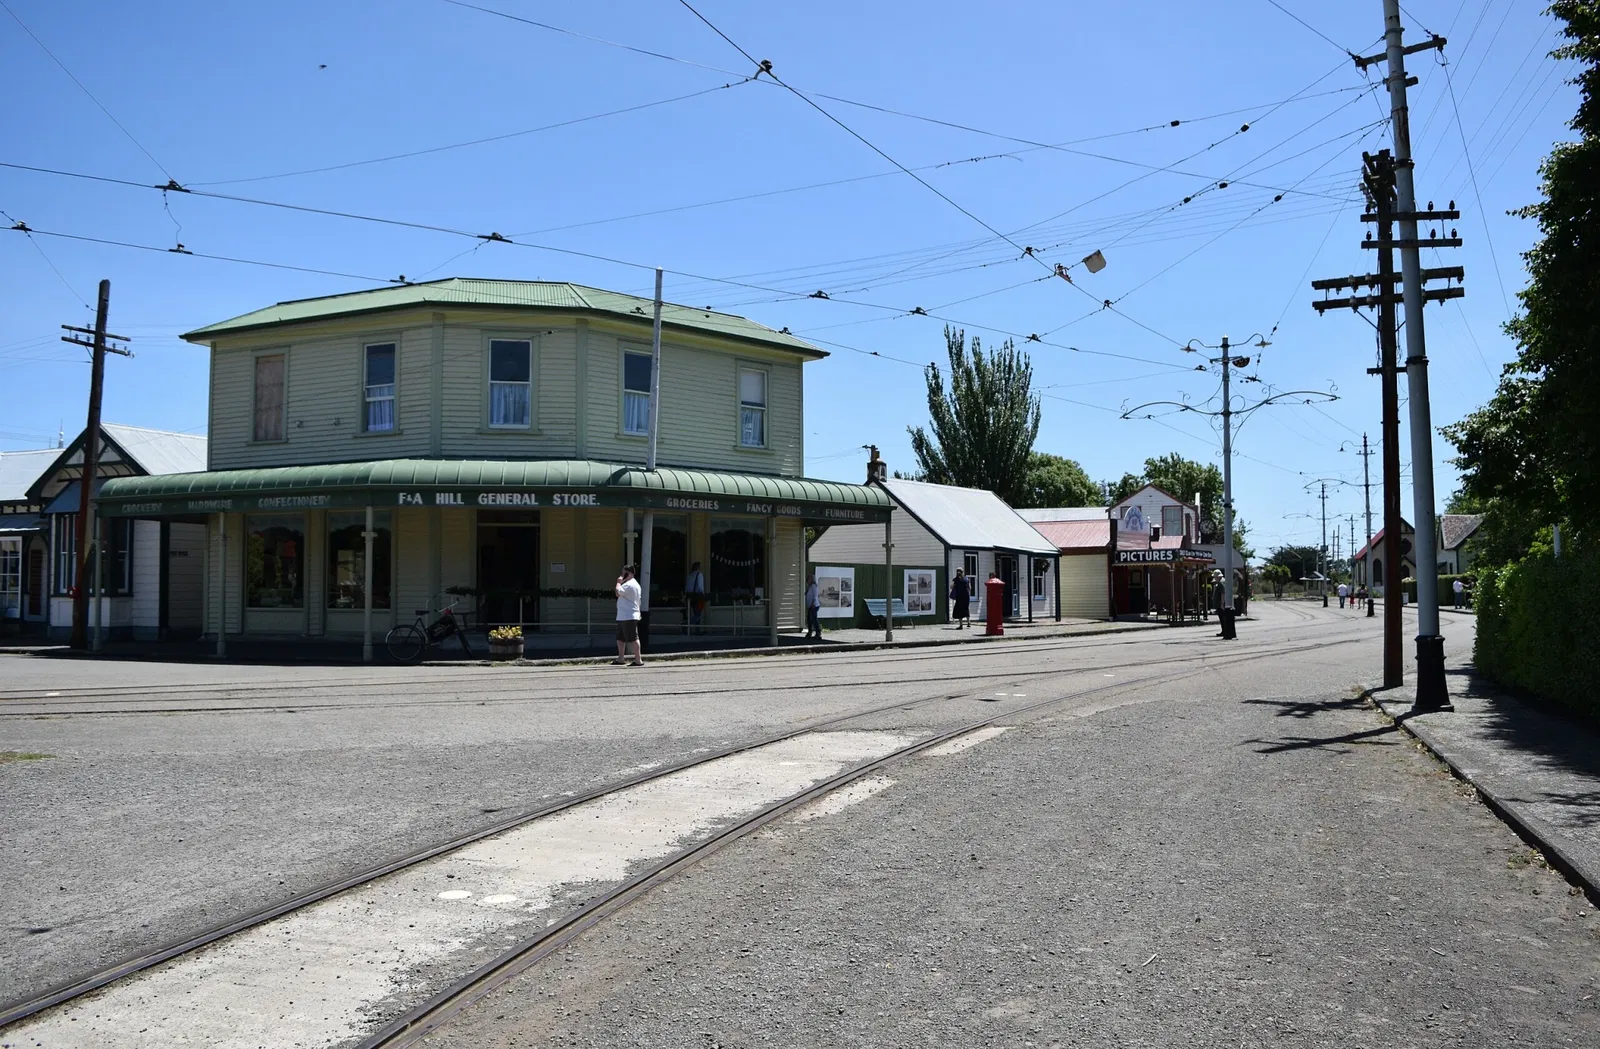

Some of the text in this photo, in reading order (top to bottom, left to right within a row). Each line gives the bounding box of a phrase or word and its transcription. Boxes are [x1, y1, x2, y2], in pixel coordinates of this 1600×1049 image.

[121, 495, 331, 513] CROCKERY HARDWARE CONFECTIONERY
[399, 492, 600, 505] F&A HILL GENERAL STORE.
[666, 497, 865, 520] GROCERIES FANCY GOODS FURNITURE
[1120, 550, 1173, 562] PICTURES
